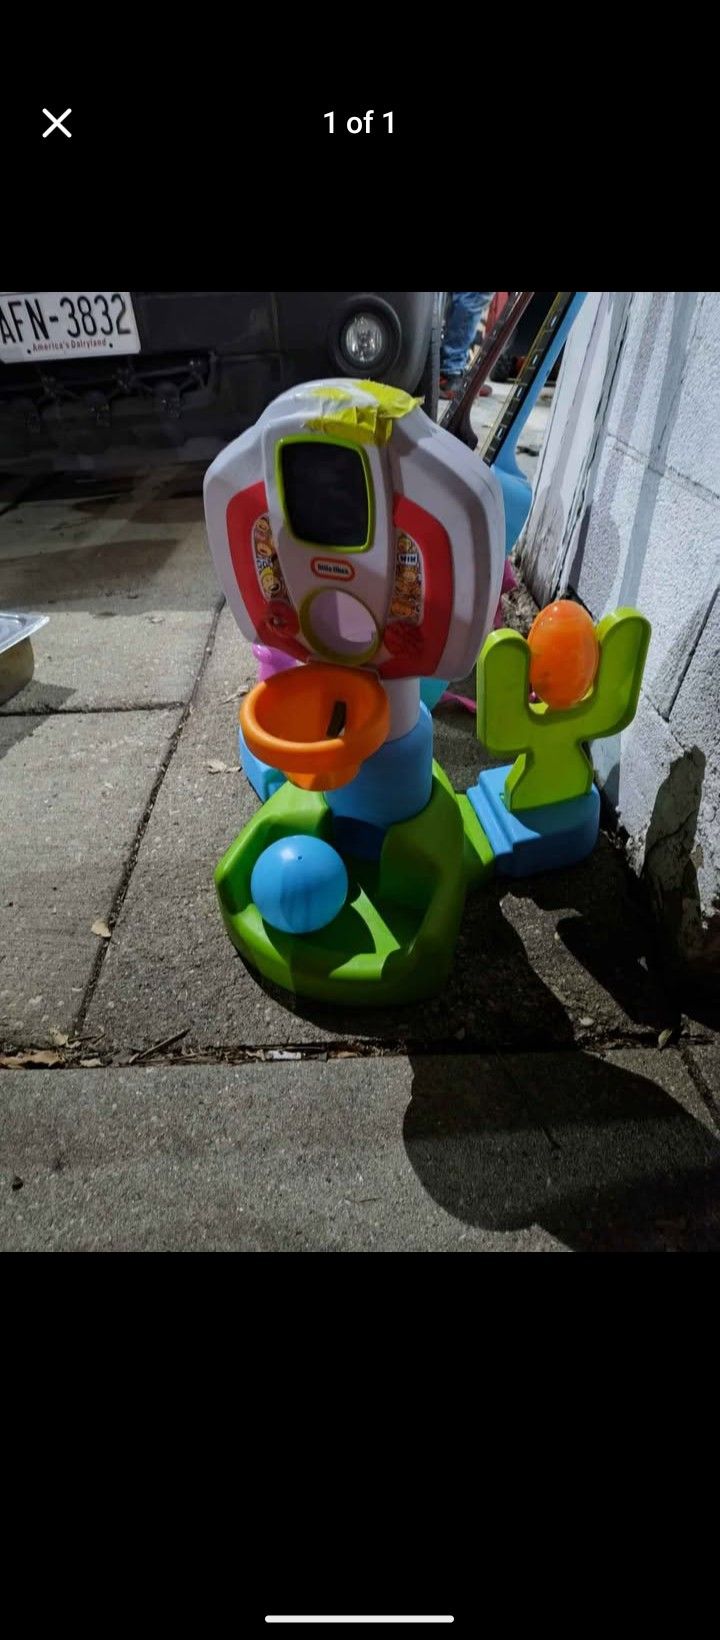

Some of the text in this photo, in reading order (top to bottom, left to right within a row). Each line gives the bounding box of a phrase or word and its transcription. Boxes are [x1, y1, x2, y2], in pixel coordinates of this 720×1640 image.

[0, 293, 131, 344] AFN-3832
[32, 338, 107, 352] America's Dairyland
